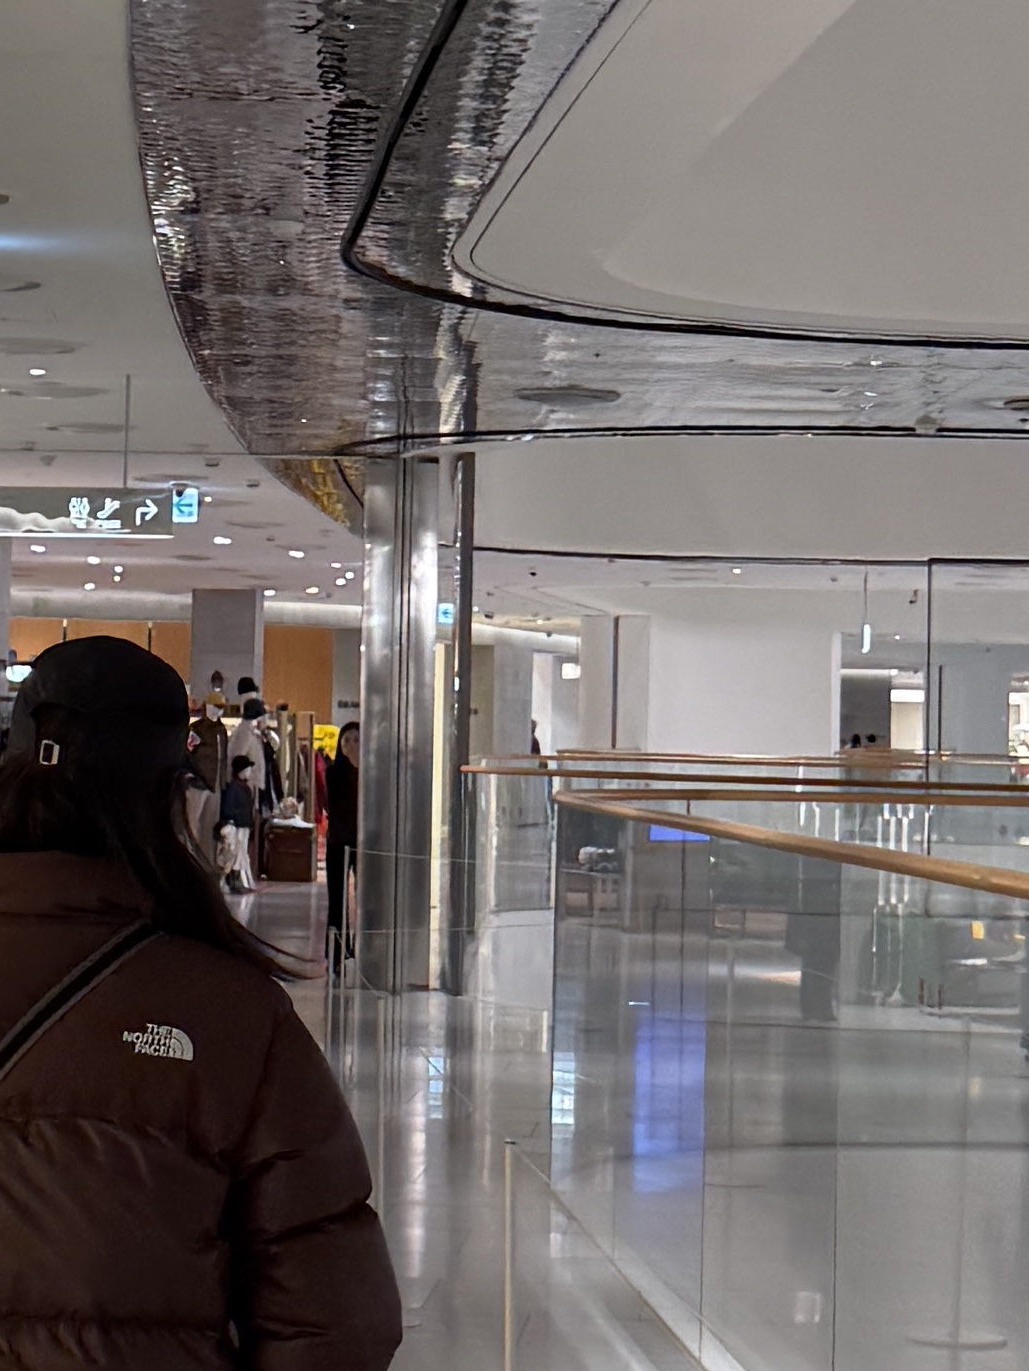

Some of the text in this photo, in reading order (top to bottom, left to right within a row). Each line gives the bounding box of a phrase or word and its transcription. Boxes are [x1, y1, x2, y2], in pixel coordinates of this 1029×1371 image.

[146, 1023, 172, 1036] THE
[122, 1031, 171, 1046] NORTH
[135, 1043, 173, 1057] FACE
